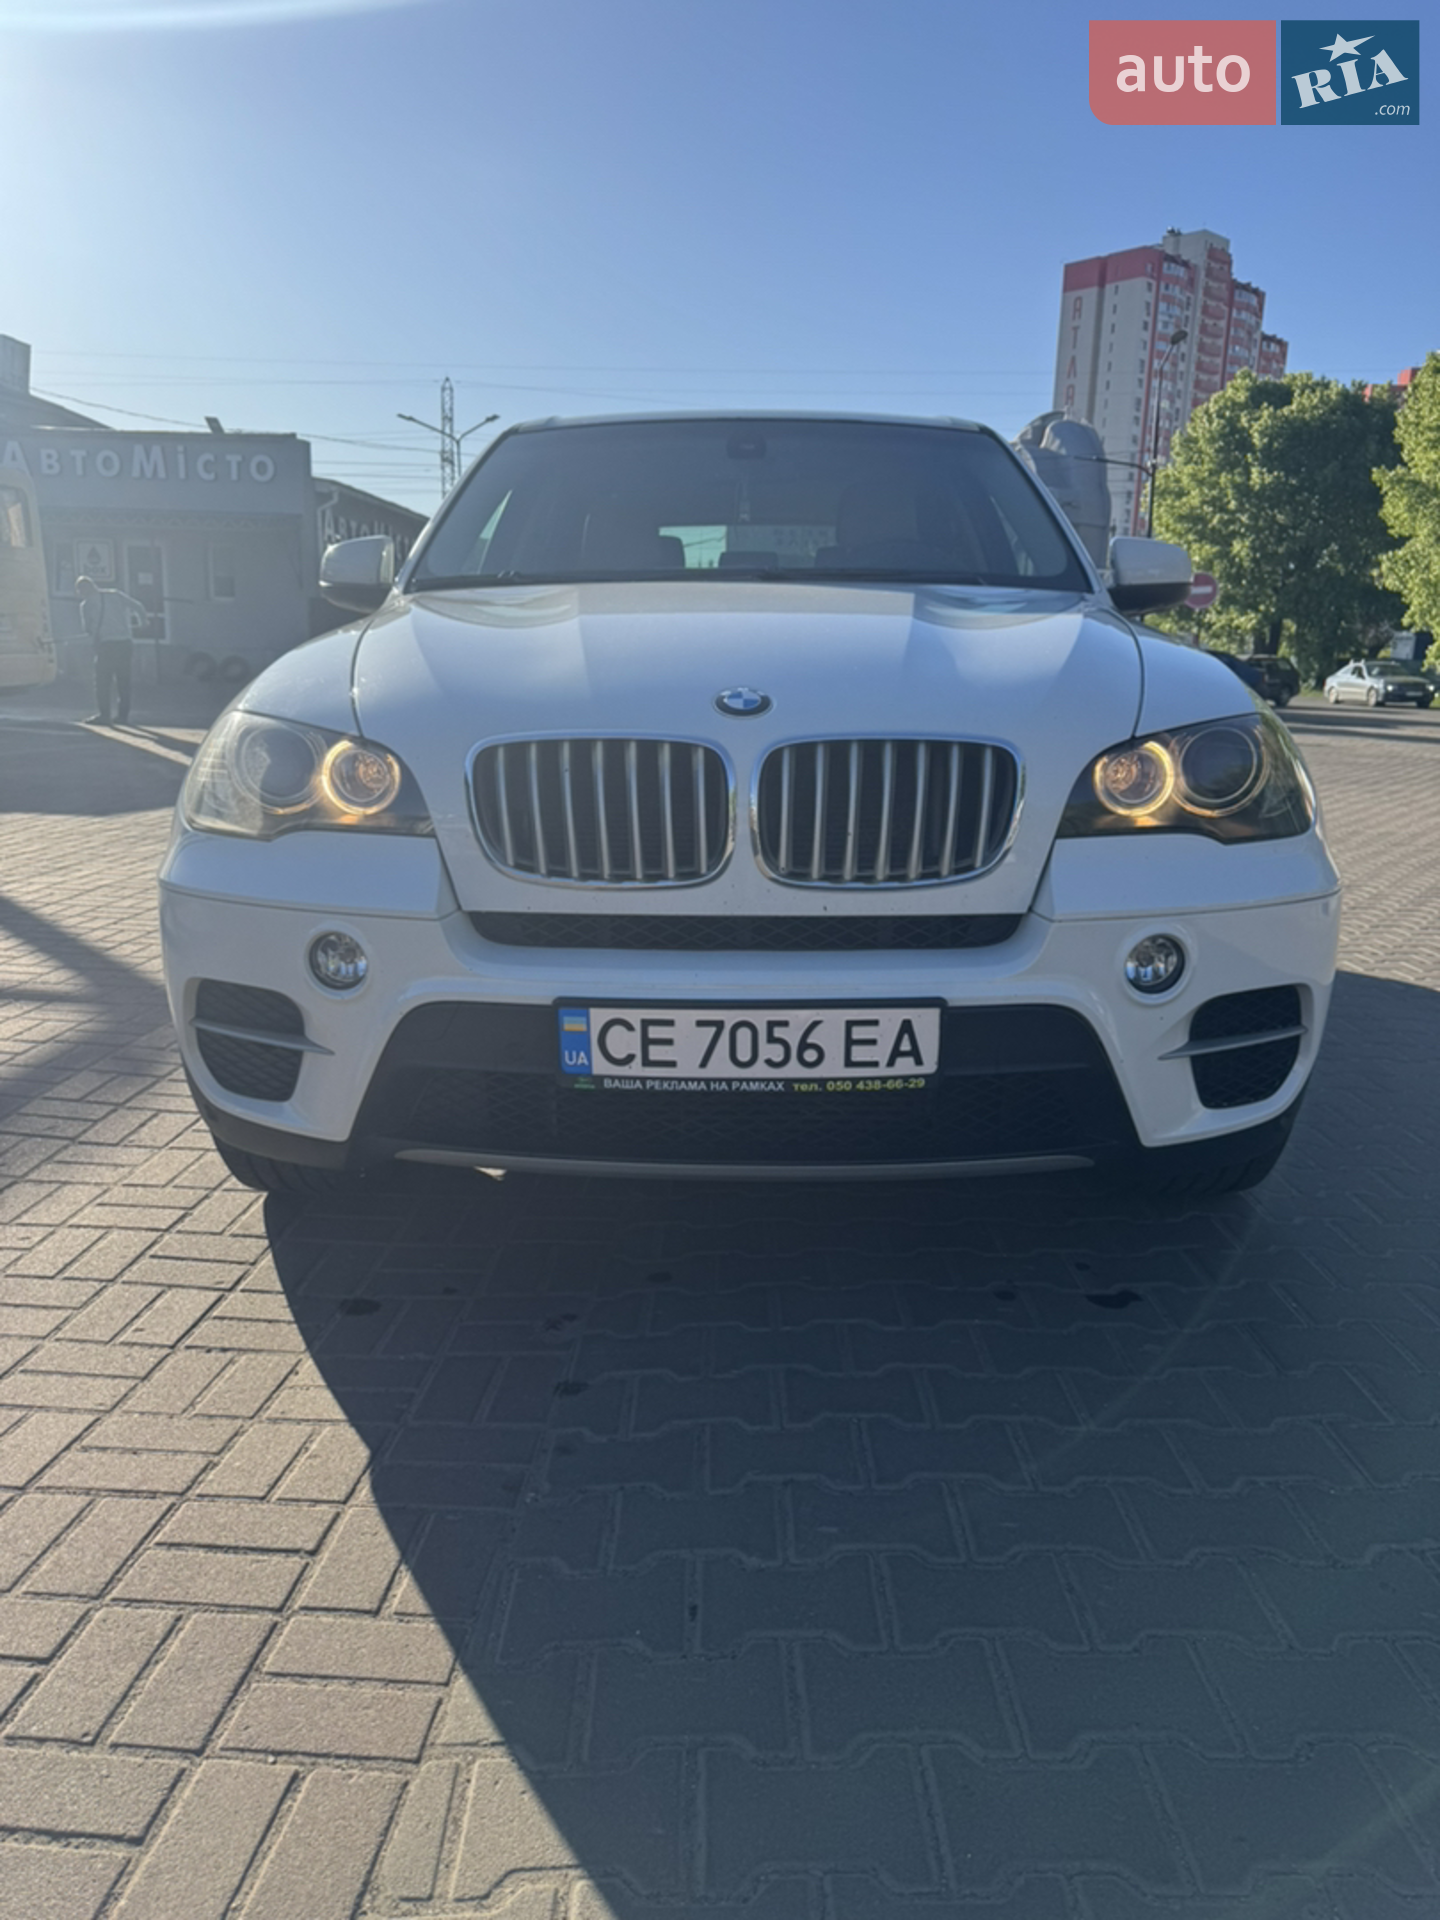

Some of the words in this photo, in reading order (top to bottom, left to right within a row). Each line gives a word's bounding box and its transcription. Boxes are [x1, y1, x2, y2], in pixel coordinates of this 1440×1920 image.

[597, 1017, 678, 1068] CE
[695, 1019, 826, 1069] 7056
[843, 1018, 924, 1068] EA
[564, 1050, 589, 1066] UA
[603, 1077, 642, 1090] ВАША
[646, 1079, 706, 1091] РЕКЛАМА
[710, 1080, 728, 1091] НА
[731, 1080, 785, 1092] РАМКАХ
[793, 1082, 822, 1091] тел.
[826, 1080, 852, 1091] 050
[856, 1077, 926, 1091] 438-66-29
